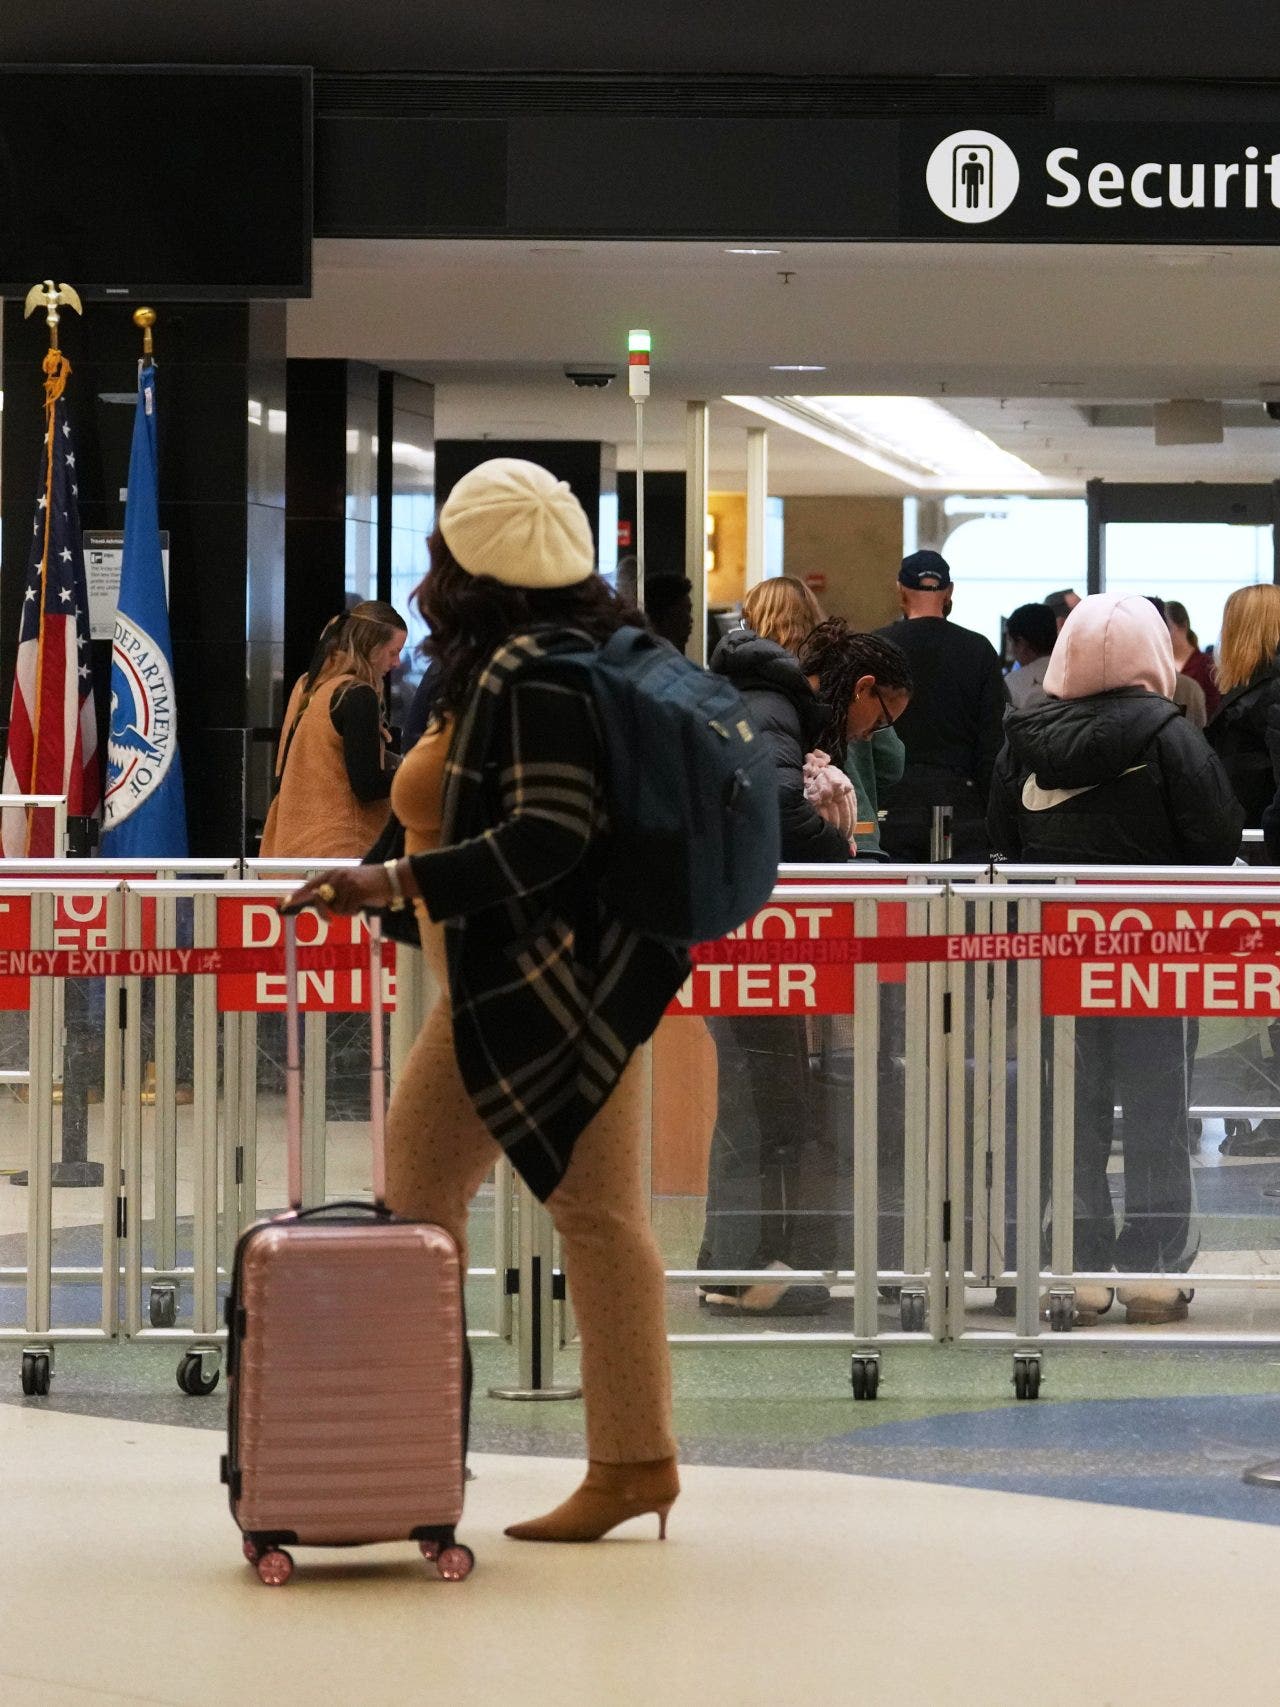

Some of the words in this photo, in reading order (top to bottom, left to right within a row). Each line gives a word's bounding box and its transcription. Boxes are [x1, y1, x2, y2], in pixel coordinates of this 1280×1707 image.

[114, 621, 170, 768] DEPARTMENT
[130, 767, 153, 799] OF
[947, 933, 1088, 960] EMERGENCY
[1095, 932, 1144, 956] EXIT
[1150, 930, 1209, 954] ONLY
[67, 951, 121, 974] EXIT
[130, 950, 193, 973] ONLY
